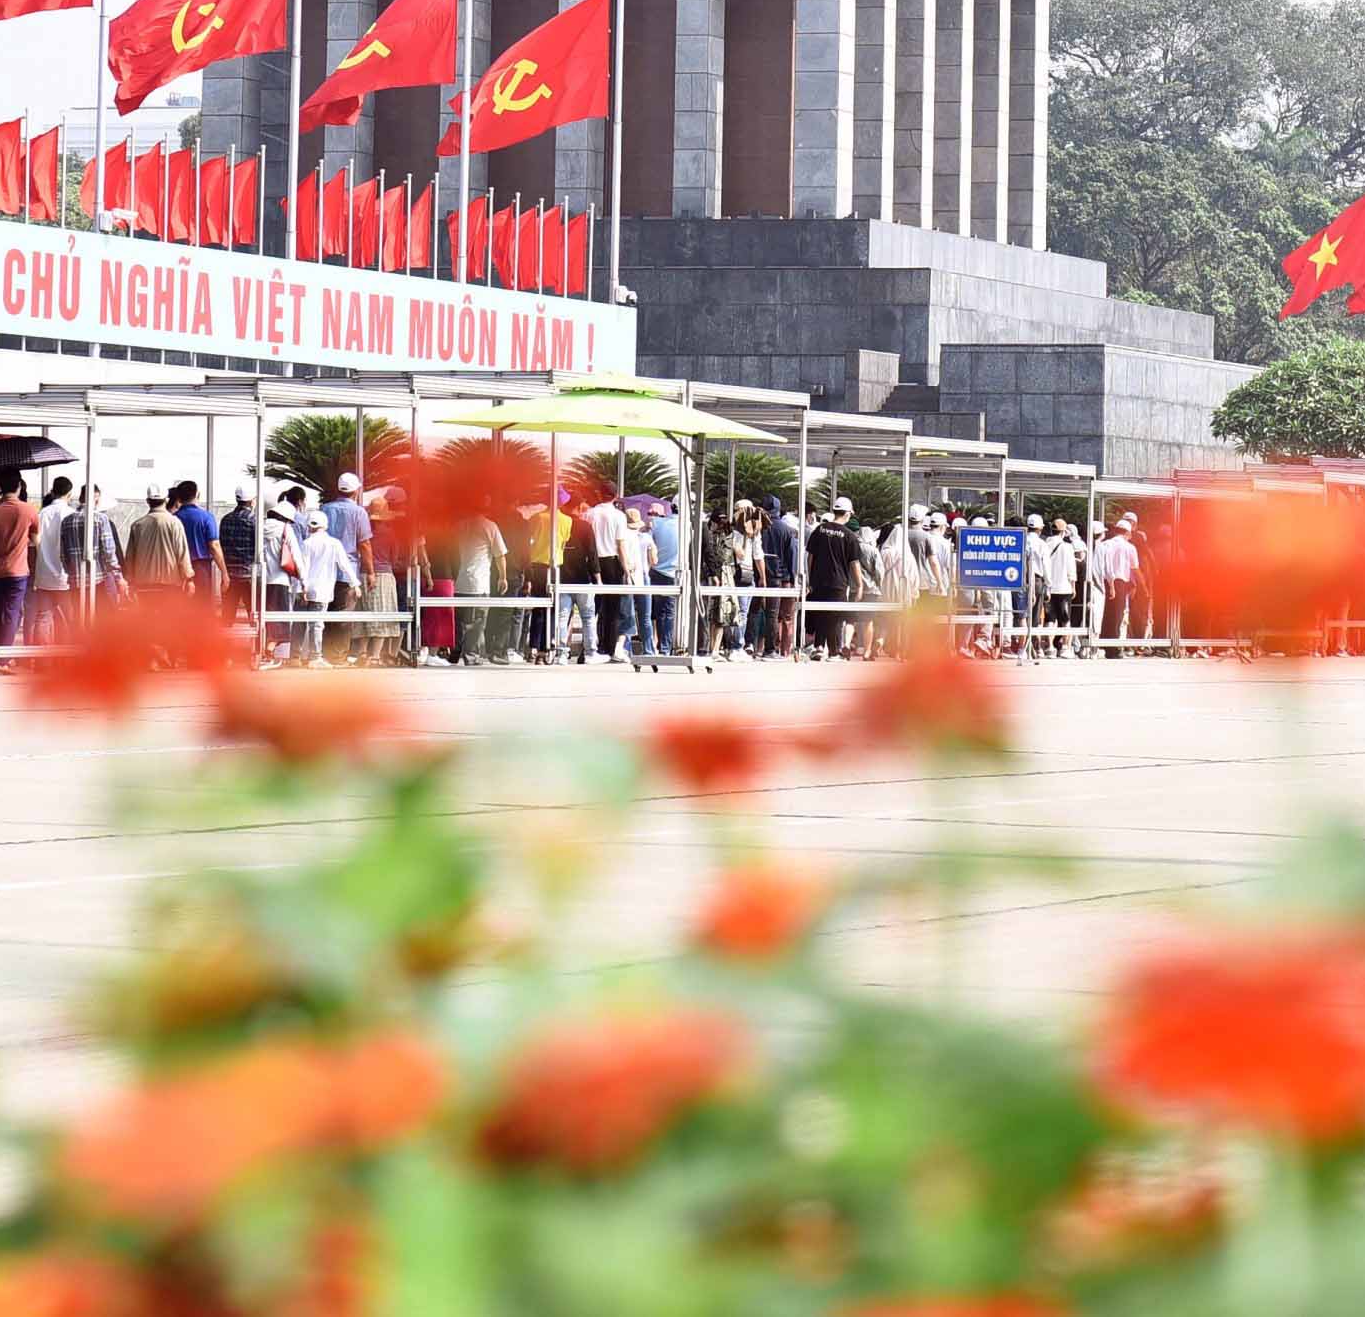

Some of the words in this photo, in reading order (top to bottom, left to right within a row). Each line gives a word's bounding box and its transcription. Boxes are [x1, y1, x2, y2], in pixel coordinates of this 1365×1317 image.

[3, 234, 81, 321] CHỦ
[100, 256, 212, 335] NGHĨA
[233, 268, 306, 354] VIỆT
[322, 290, 394, 355] NAM
[408, 294, 496, 367] MUÔN
[511, 304, 573, 372] NĂM
[966, 534, 990, 546] KHU
[993, 534, 1017, 549] VỰC
